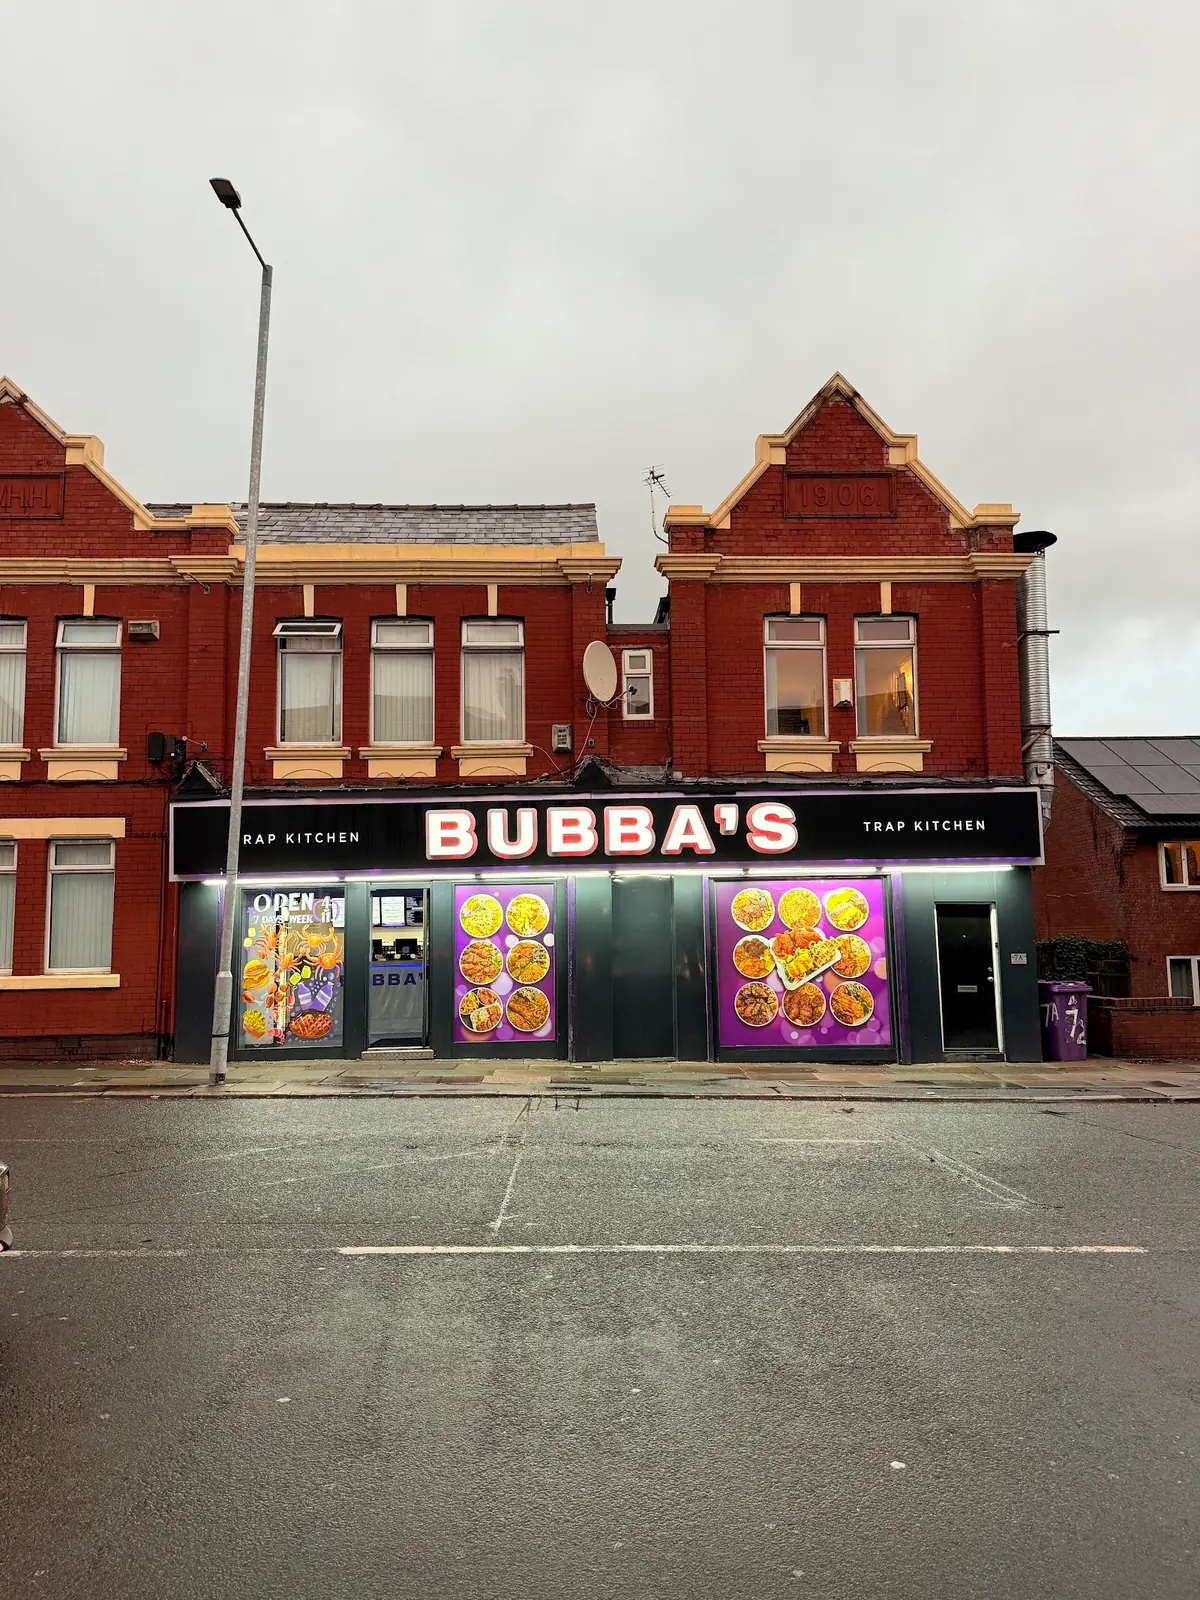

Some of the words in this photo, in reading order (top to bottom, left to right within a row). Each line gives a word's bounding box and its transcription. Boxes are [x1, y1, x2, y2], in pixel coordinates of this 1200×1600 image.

[425, 803, 798, 860] BUBBA'S
[863, 821, 905, 832] TRAP
[914, 820, 985, 831] KITCHEN
[243, 833, 276, 845] RAP
[285, 831, 359, 844] KITCHEN
[253, 892, 314, 912] OPEN
[253, 916, 259, 924] 7
[262, 915, 284, 924] DAYS
[289, 914, 314, 924] WEEK
[372, 972, 423, 986] BBA'
[1040, 1002, 1060, 1027] 7A
